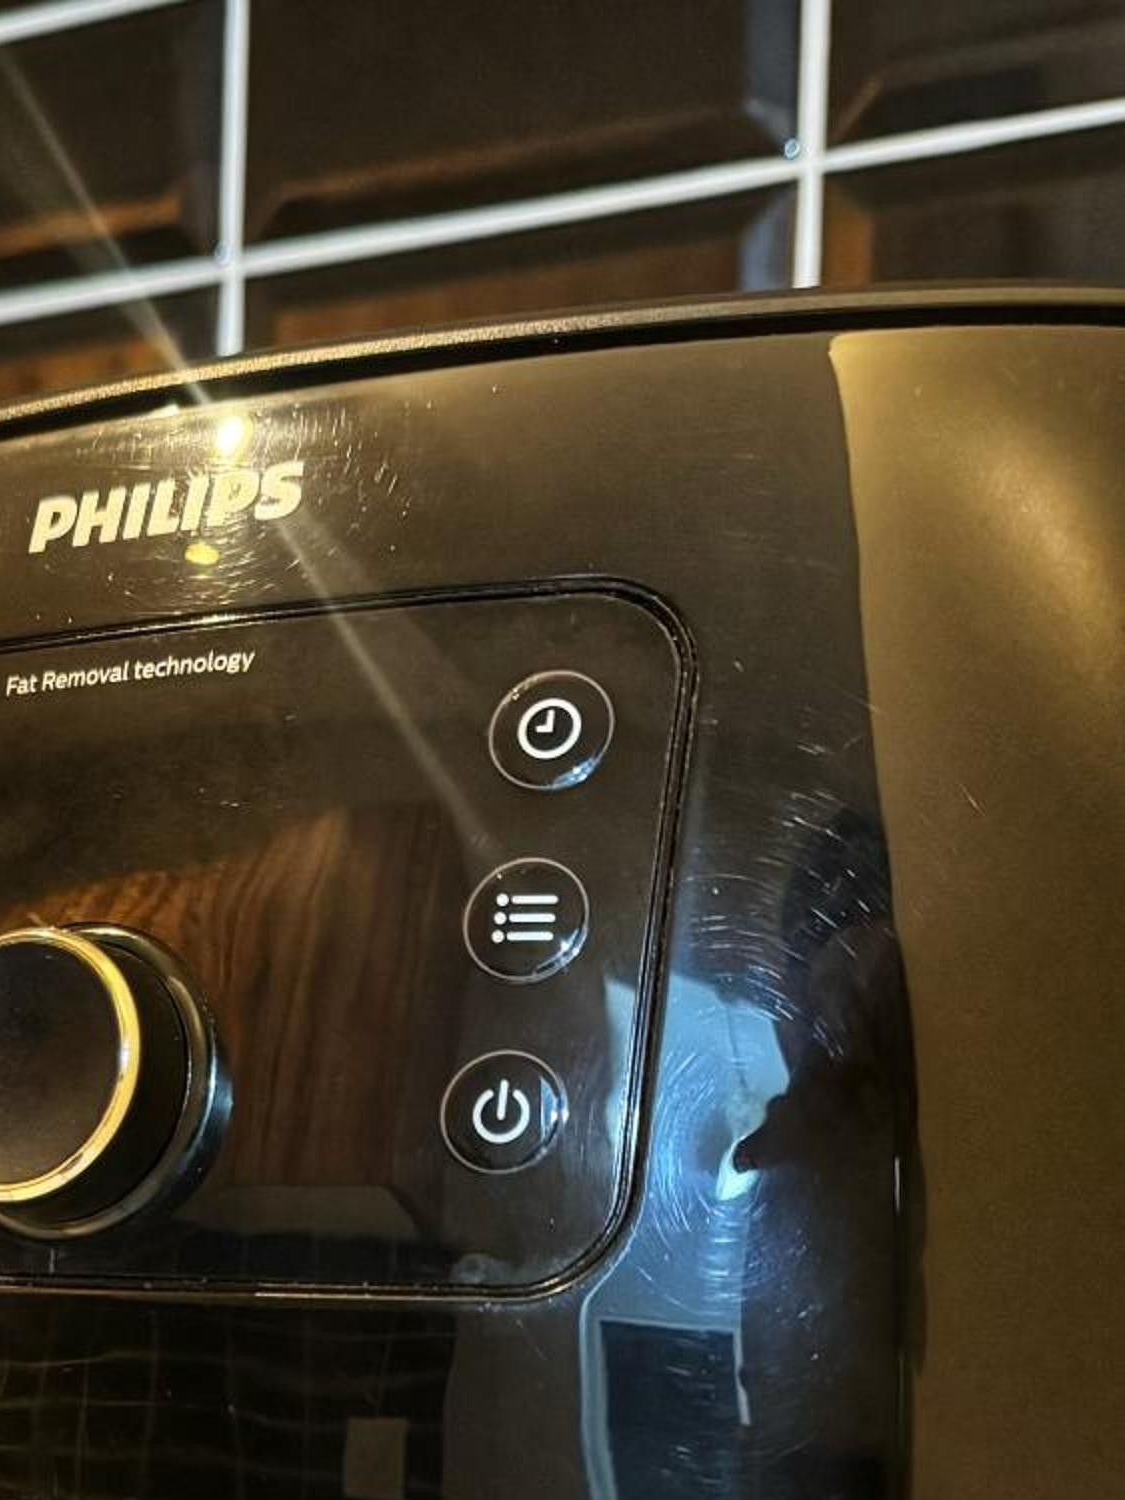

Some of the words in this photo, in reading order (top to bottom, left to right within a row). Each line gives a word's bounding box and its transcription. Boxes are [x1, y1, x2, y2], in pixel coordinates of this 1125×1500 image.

[28, 461, 304, 554] PHILIPS
[6, 675, 37, 697] Fat
[41, 661, 129, 692] Removal
[134, 650, 256, 682] technology
